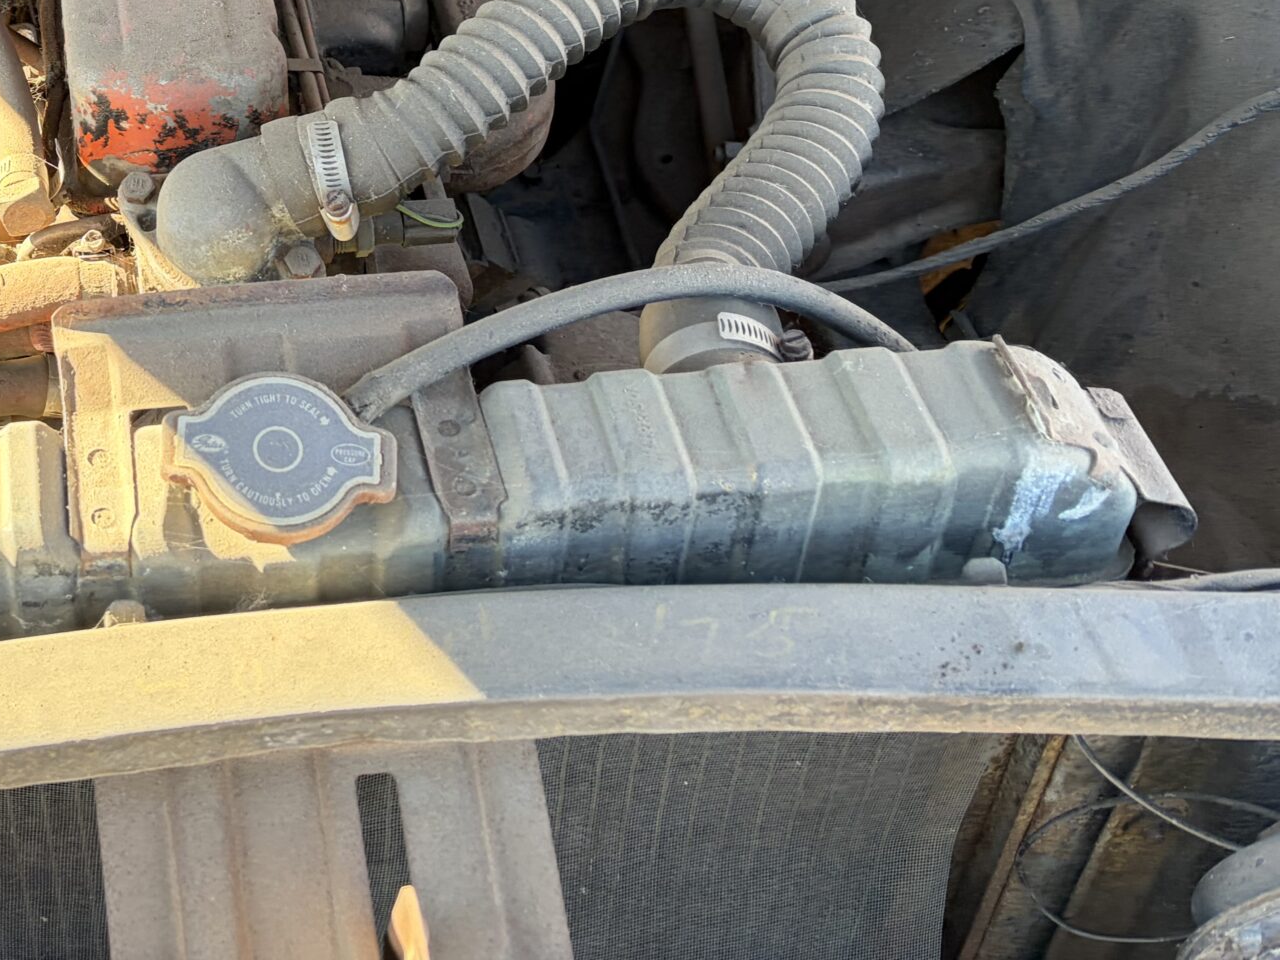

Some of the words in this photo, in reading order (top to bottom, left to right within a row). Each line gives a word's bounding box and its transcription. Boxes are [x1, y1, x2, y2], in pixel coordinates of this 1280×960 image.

[230, 399, 253, 418] TURN
[254, 393, 281, 406] TIGHT
[285, 394, 298, 406] TO
[299, 399, 321, 419] SEAL
[334, 448, 366, 458] PRESSURE
[219, 459, 238, 483] TURN
[235, 481, 294, 507] CAUTIOUSLY
[296, 491, 311, 503] TO
[310, 475, 333, 496] OPEN
